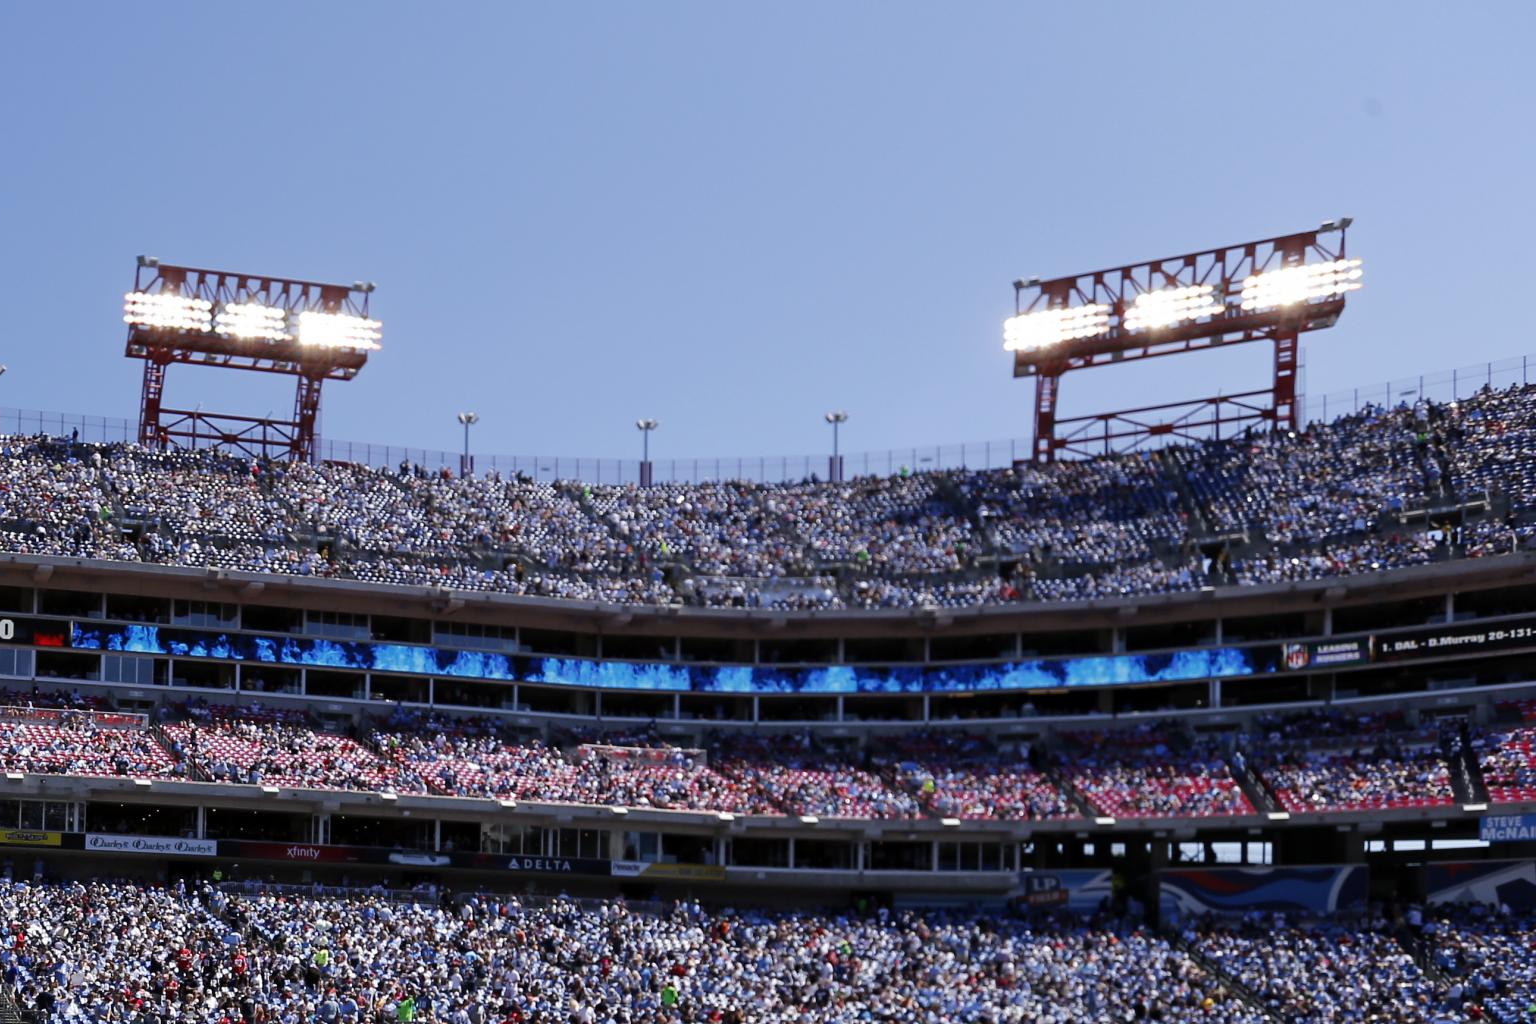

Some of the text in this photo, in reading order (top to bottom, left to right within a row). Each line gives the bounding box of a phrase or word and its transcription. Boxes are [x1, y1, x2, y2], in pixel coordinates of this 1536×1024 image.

[0, 619, 14, 640] 0
[1486, 816, 1522, 828] STEVE
[286, 846, 320, 860] xfinity
[524, 859, 571, 871] DELTA
